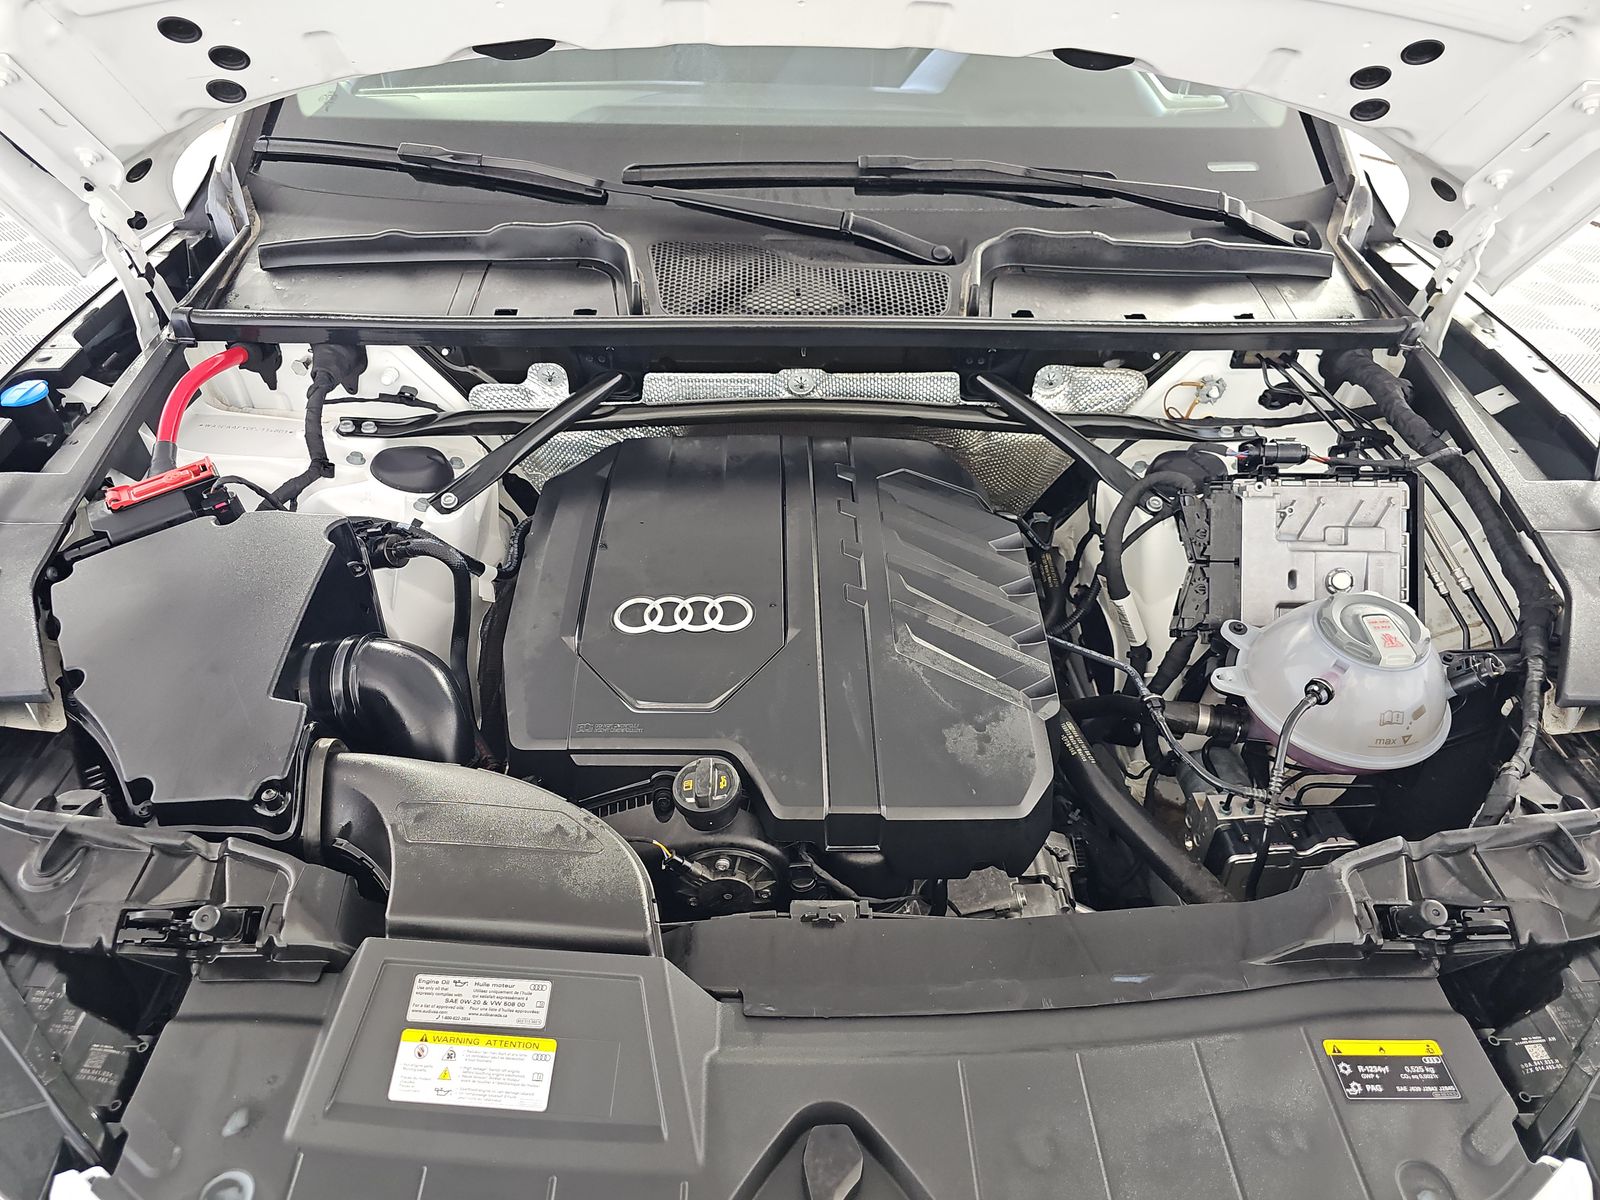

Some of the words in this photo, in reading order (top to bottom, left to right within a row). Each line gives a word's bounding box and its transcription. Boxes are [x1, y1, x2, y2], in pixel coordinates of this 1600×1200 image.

[1374, 737, 1397, 746] max
[432, 1035, 480, 1046] WARNING
[485, 1039, 540, 1050] ATTENTION
[1357, 1065, 1389, 1074] R-1234yf
[1404, 1065, 1424, 1073] 0,525
[1424, 1066, 1435, 1074] kg
[1365, 1084, 1384, 1092] PAG
